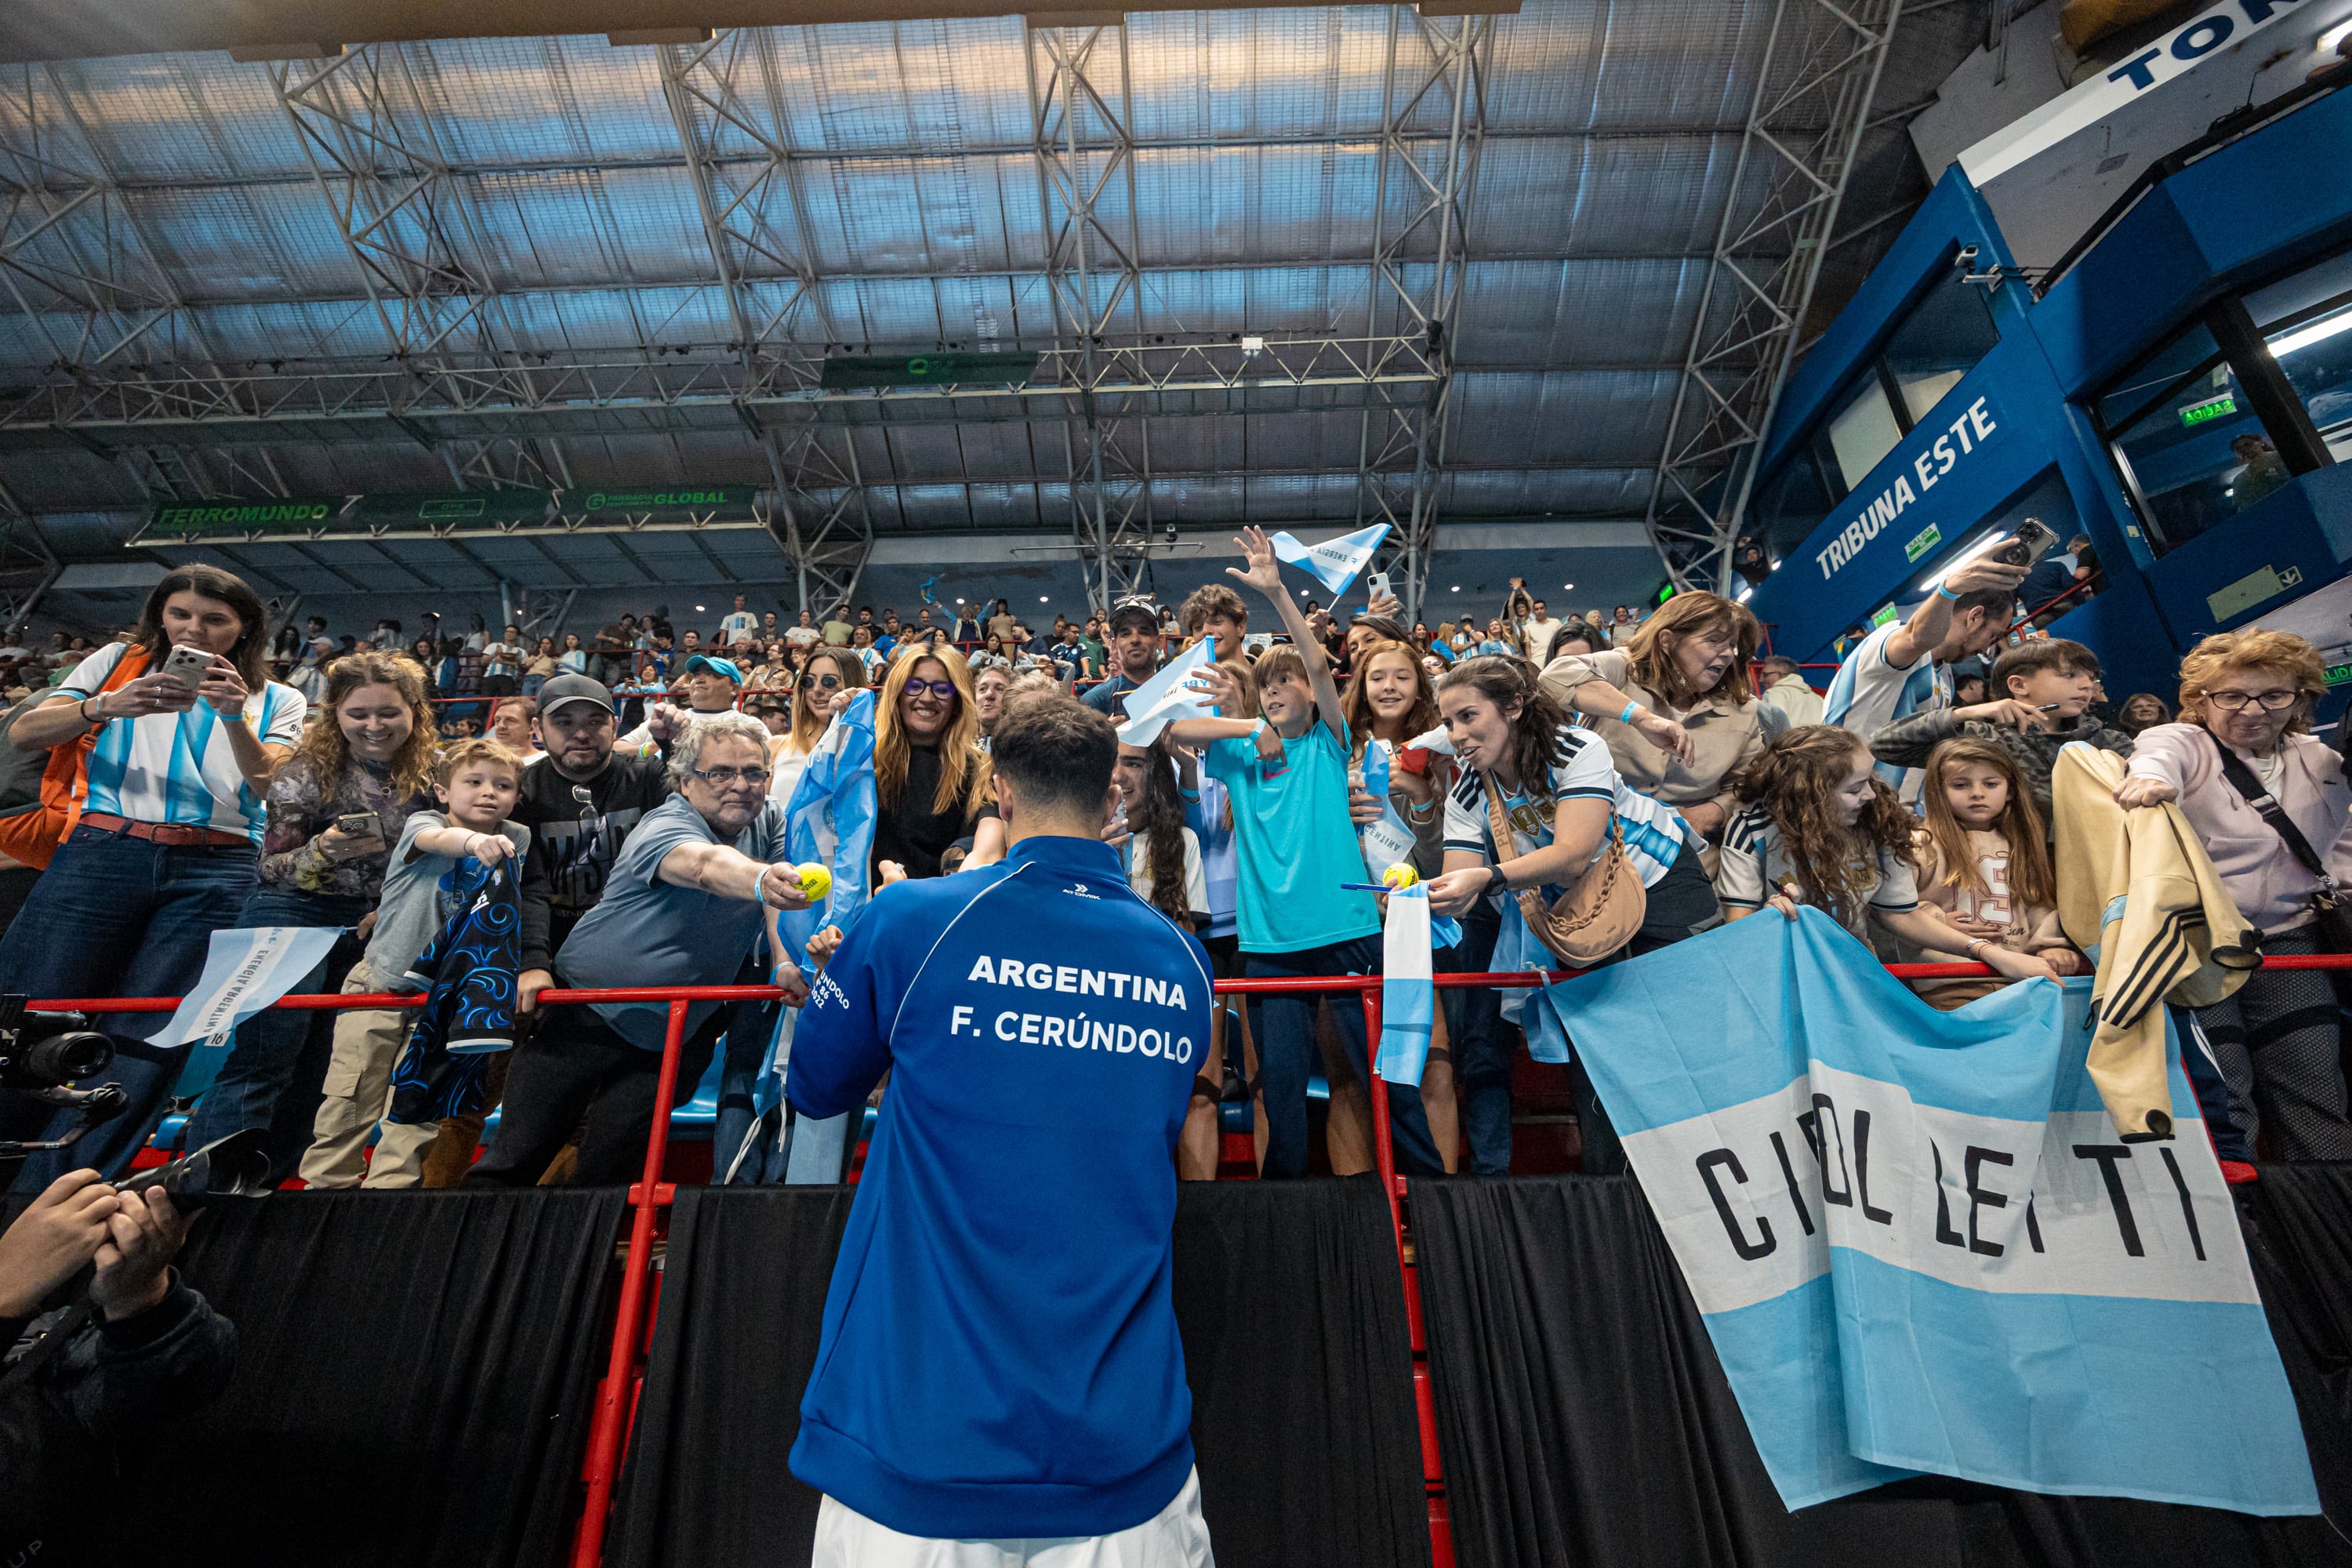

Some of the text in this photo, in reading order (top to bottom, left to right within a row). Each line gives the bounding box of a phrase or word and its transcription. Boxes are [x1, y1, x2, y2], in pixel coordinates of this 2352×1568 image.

[653, 492, 728, 505] GLOBAL
[1816, 396, 1997, 580] TRIBUNA ESTE
[159, 504, 329, 523] FERROMUNDO
[1907, 528, 1933, 550] SALIDA
[819, 985, 830, 1000] 86
[820, 969, 850, 1010] UNDOLO
[967, 955, 1187, 1011] ARGENTINA
[211, 1033, 224, 1045] 16
[950, 1005, 1192, 1065] F. CERÚNDOLO
[1696, 1092, 2208, 1261] CIOLLETI
